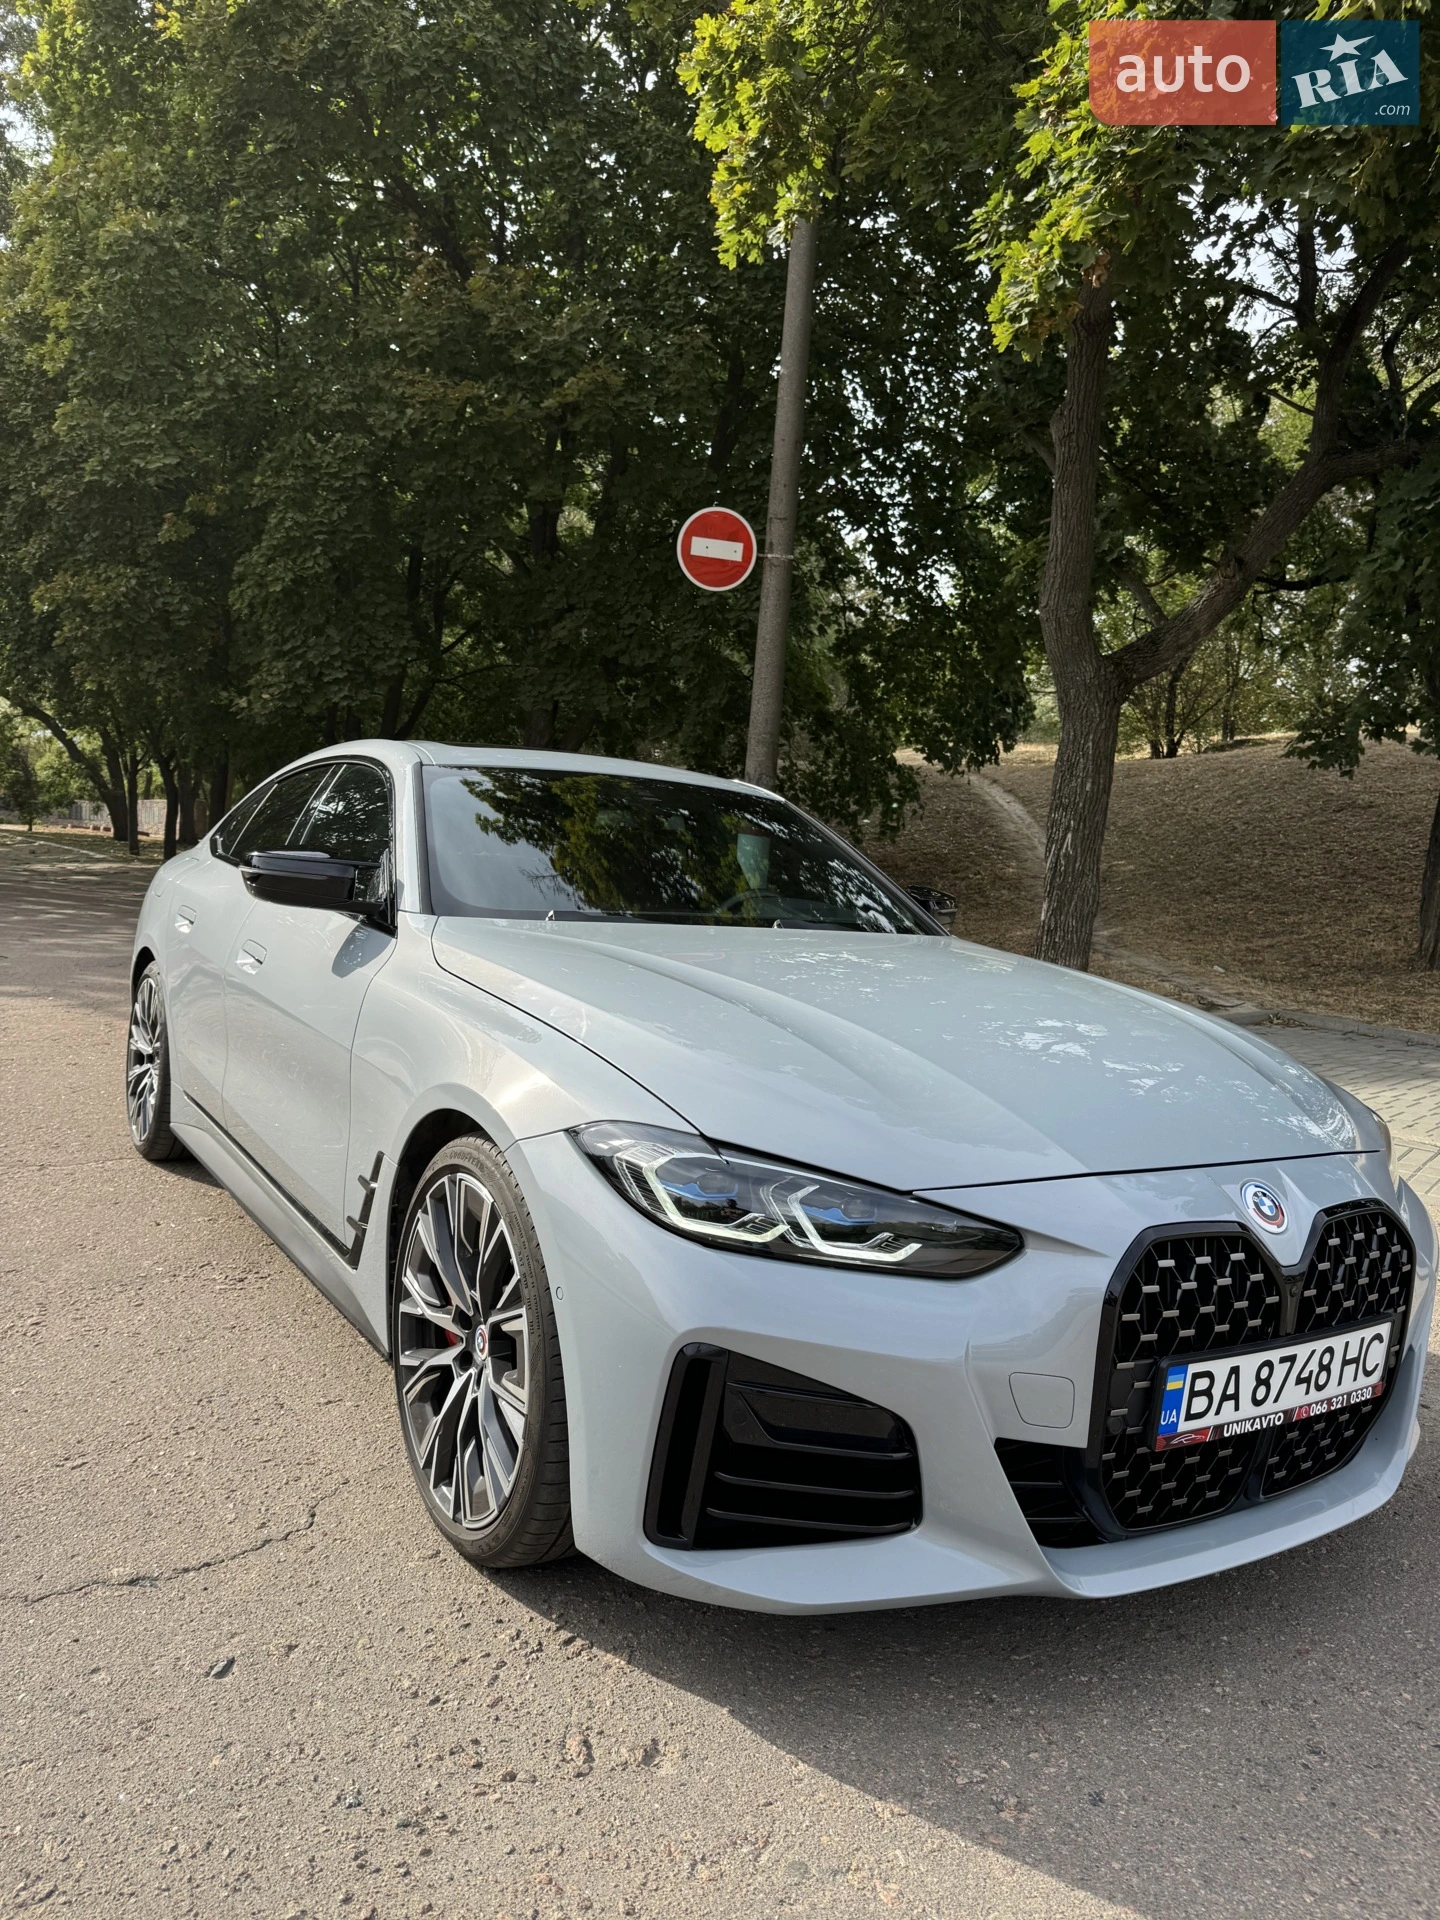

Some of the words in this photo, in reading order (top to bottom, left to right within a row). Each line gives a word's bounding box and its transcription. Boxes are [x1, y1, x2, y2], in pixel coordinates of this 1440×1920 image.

[1183, 1365, 1240, 1422] BA
[1251, 1345, 1335, 1408] 8748
[1337, 1332, 1384, 1387] HC
[1160, 1409, 1177, 1426] UA
[1223, 1412, 1284, 1437] UNIKAVTO
[1310, 1399, 1327, 1417] 066
[1330, 1394, 1347, 1411] 321
[1350, 1387, 1372, 1404] 0330
